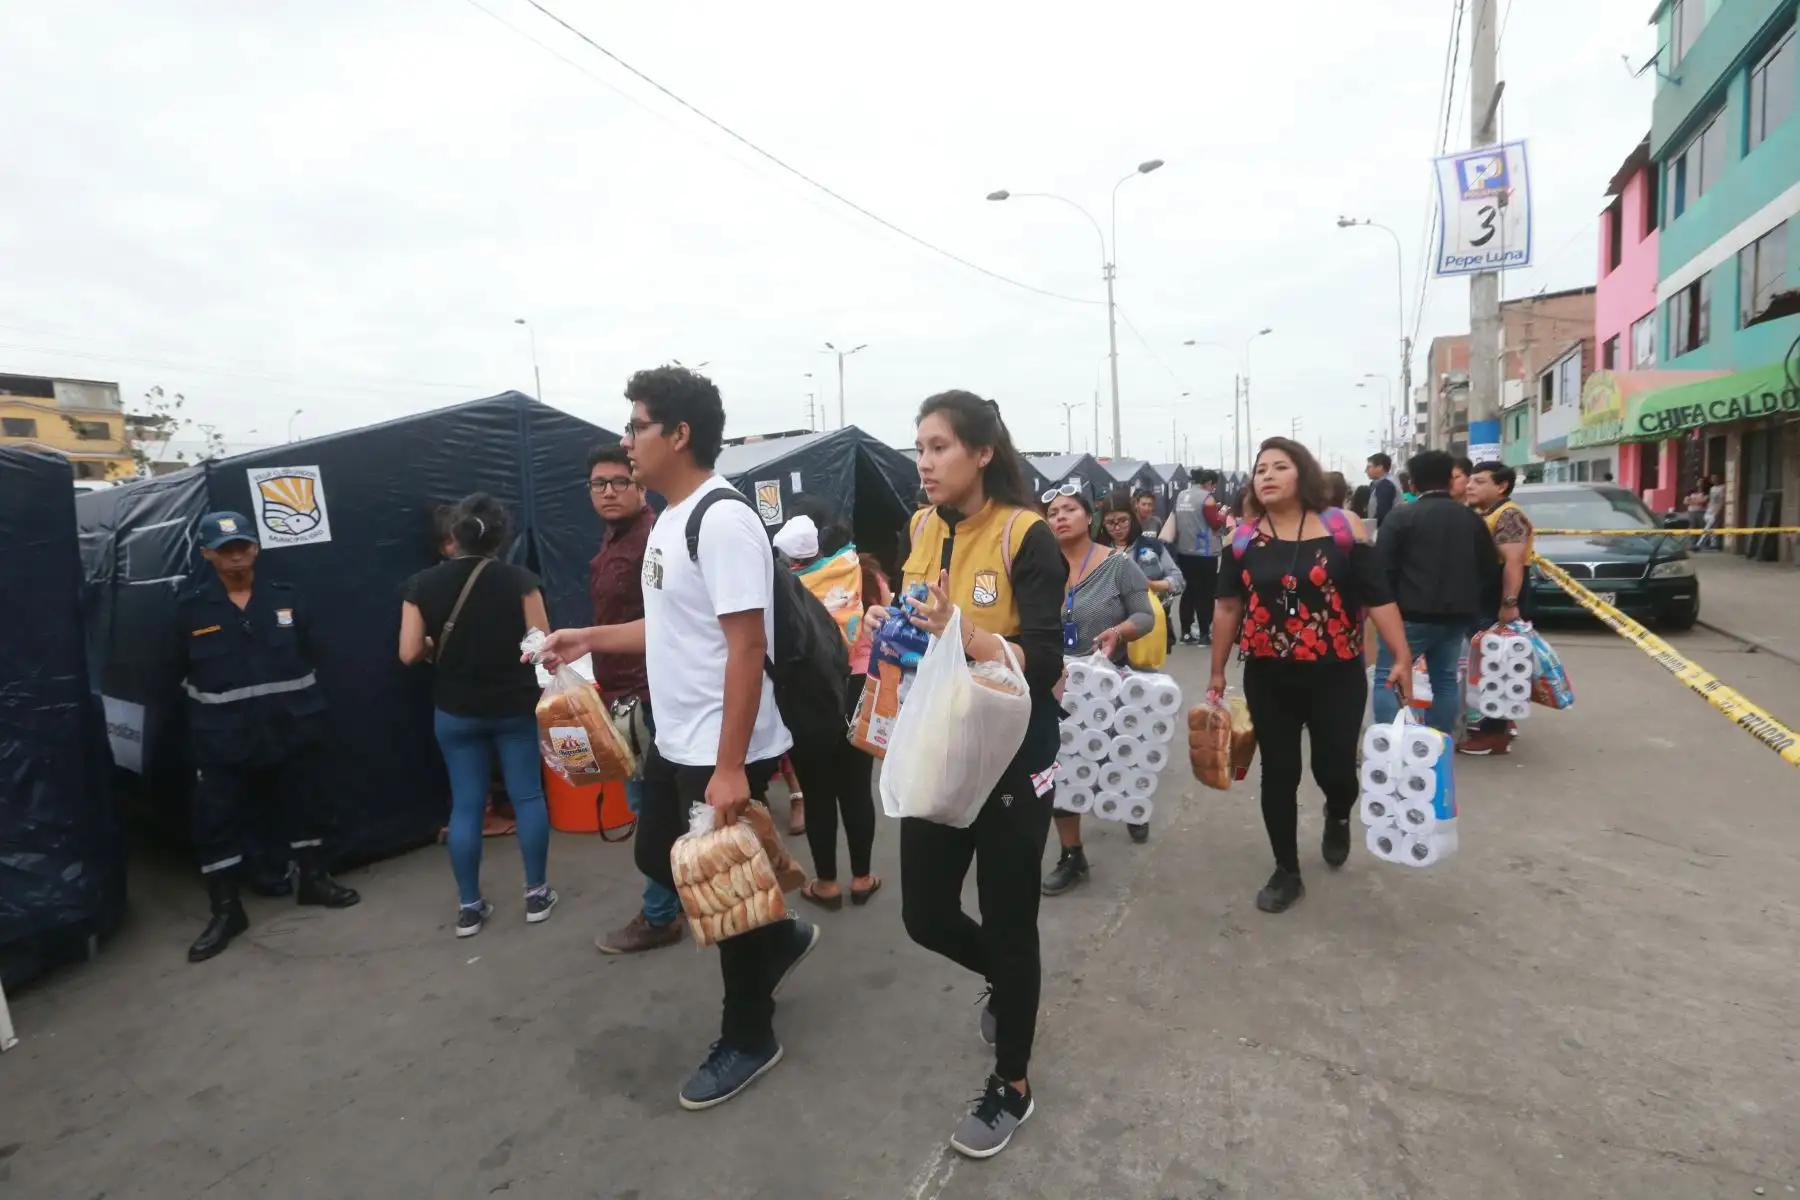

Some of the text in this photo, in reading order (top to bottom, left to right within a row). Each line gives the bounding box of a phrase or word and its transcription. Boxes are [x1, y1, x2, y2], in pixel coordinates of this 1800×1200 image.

[1469, 205, 1497, 247] 3
[1445, 249, 1524, 268] Pepe Luna
[1639, 403, 1707, 432] CHIFA
